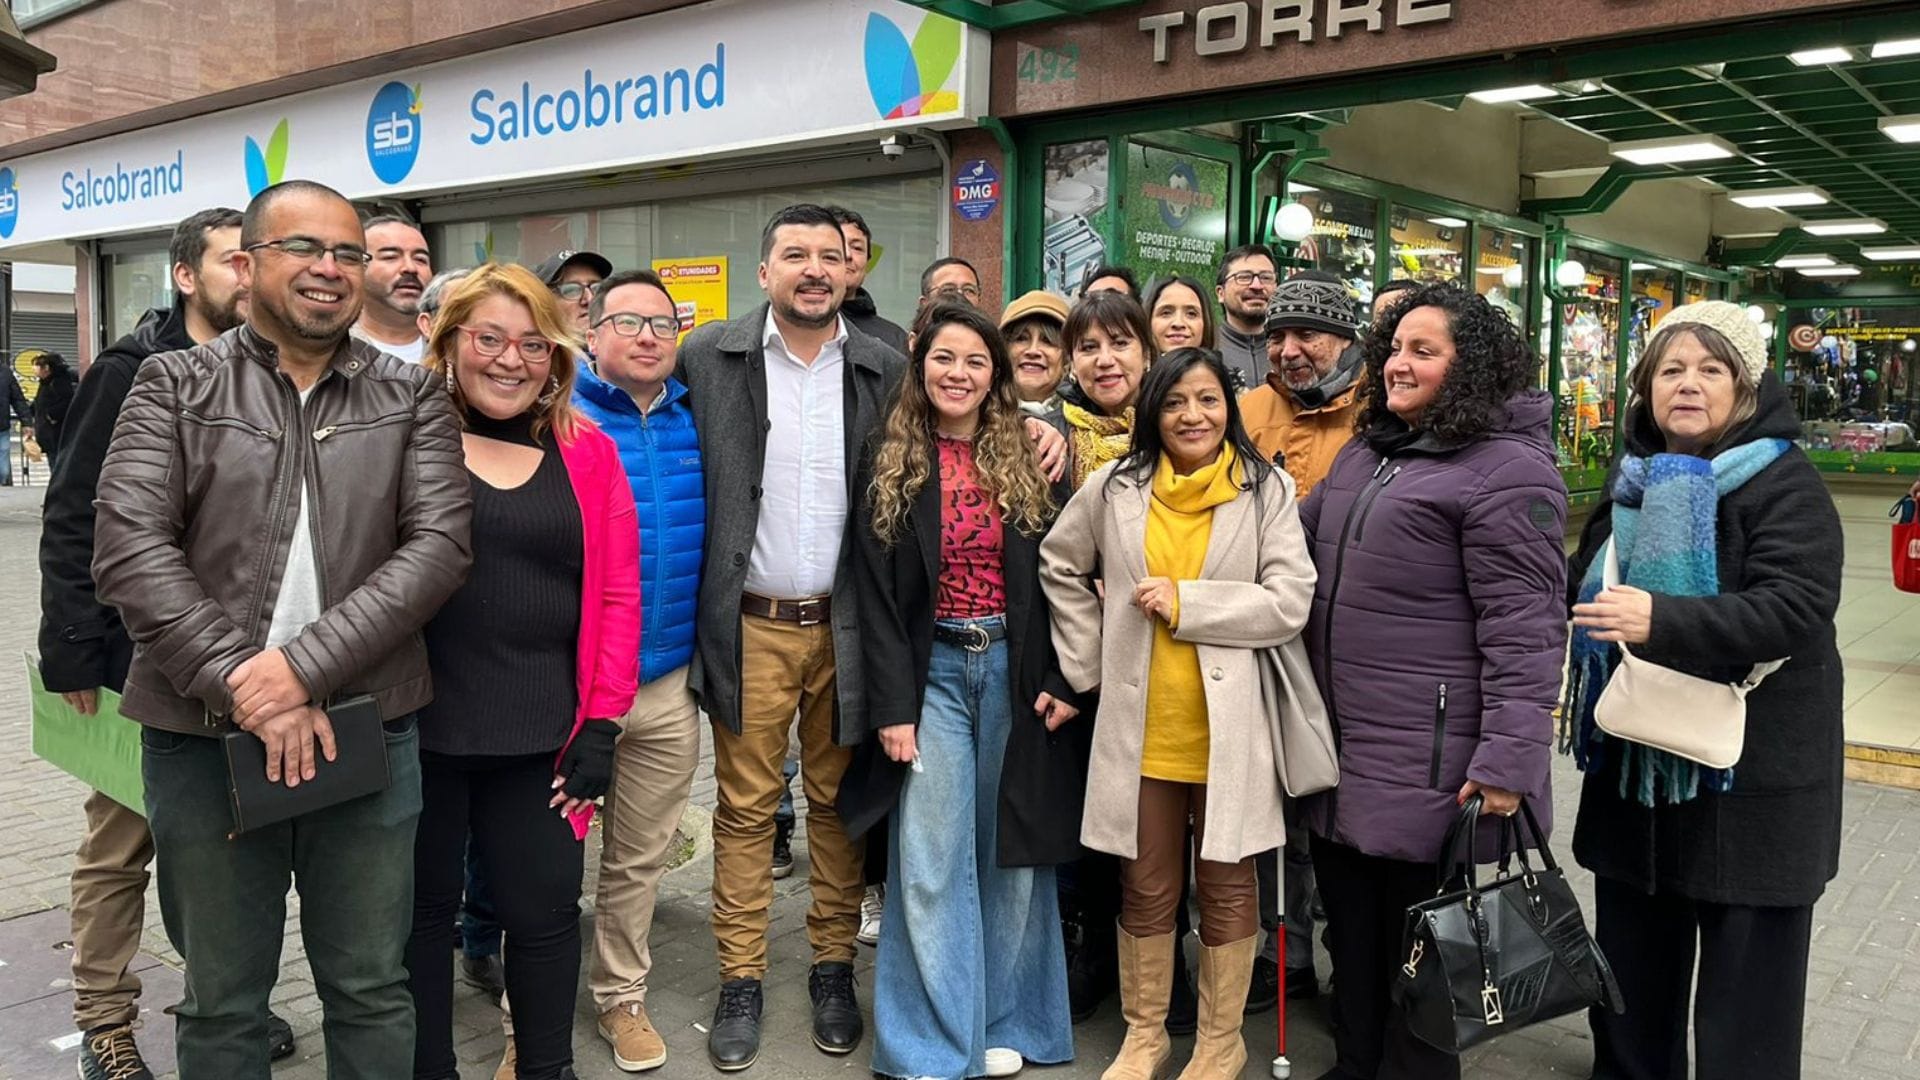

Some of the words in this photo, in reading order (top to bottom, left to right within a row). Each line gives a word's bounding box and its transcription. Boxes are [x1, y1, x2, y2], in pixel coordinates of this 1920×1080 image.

[1019, 42, 1079, 84] 492
[470, 42, 725, 145] Salcobrand
[62, 149, 183, 211] Salcobrand
[959, 183, 993, 200] DMG
[1136, 231, 1177, 248] DEPORTES
[1181, 237, 1216, 253] REGALOS
[1139, 246, 1171, 262] MENAJE
[1175, 250, 1212, 265] OUTDOOR
